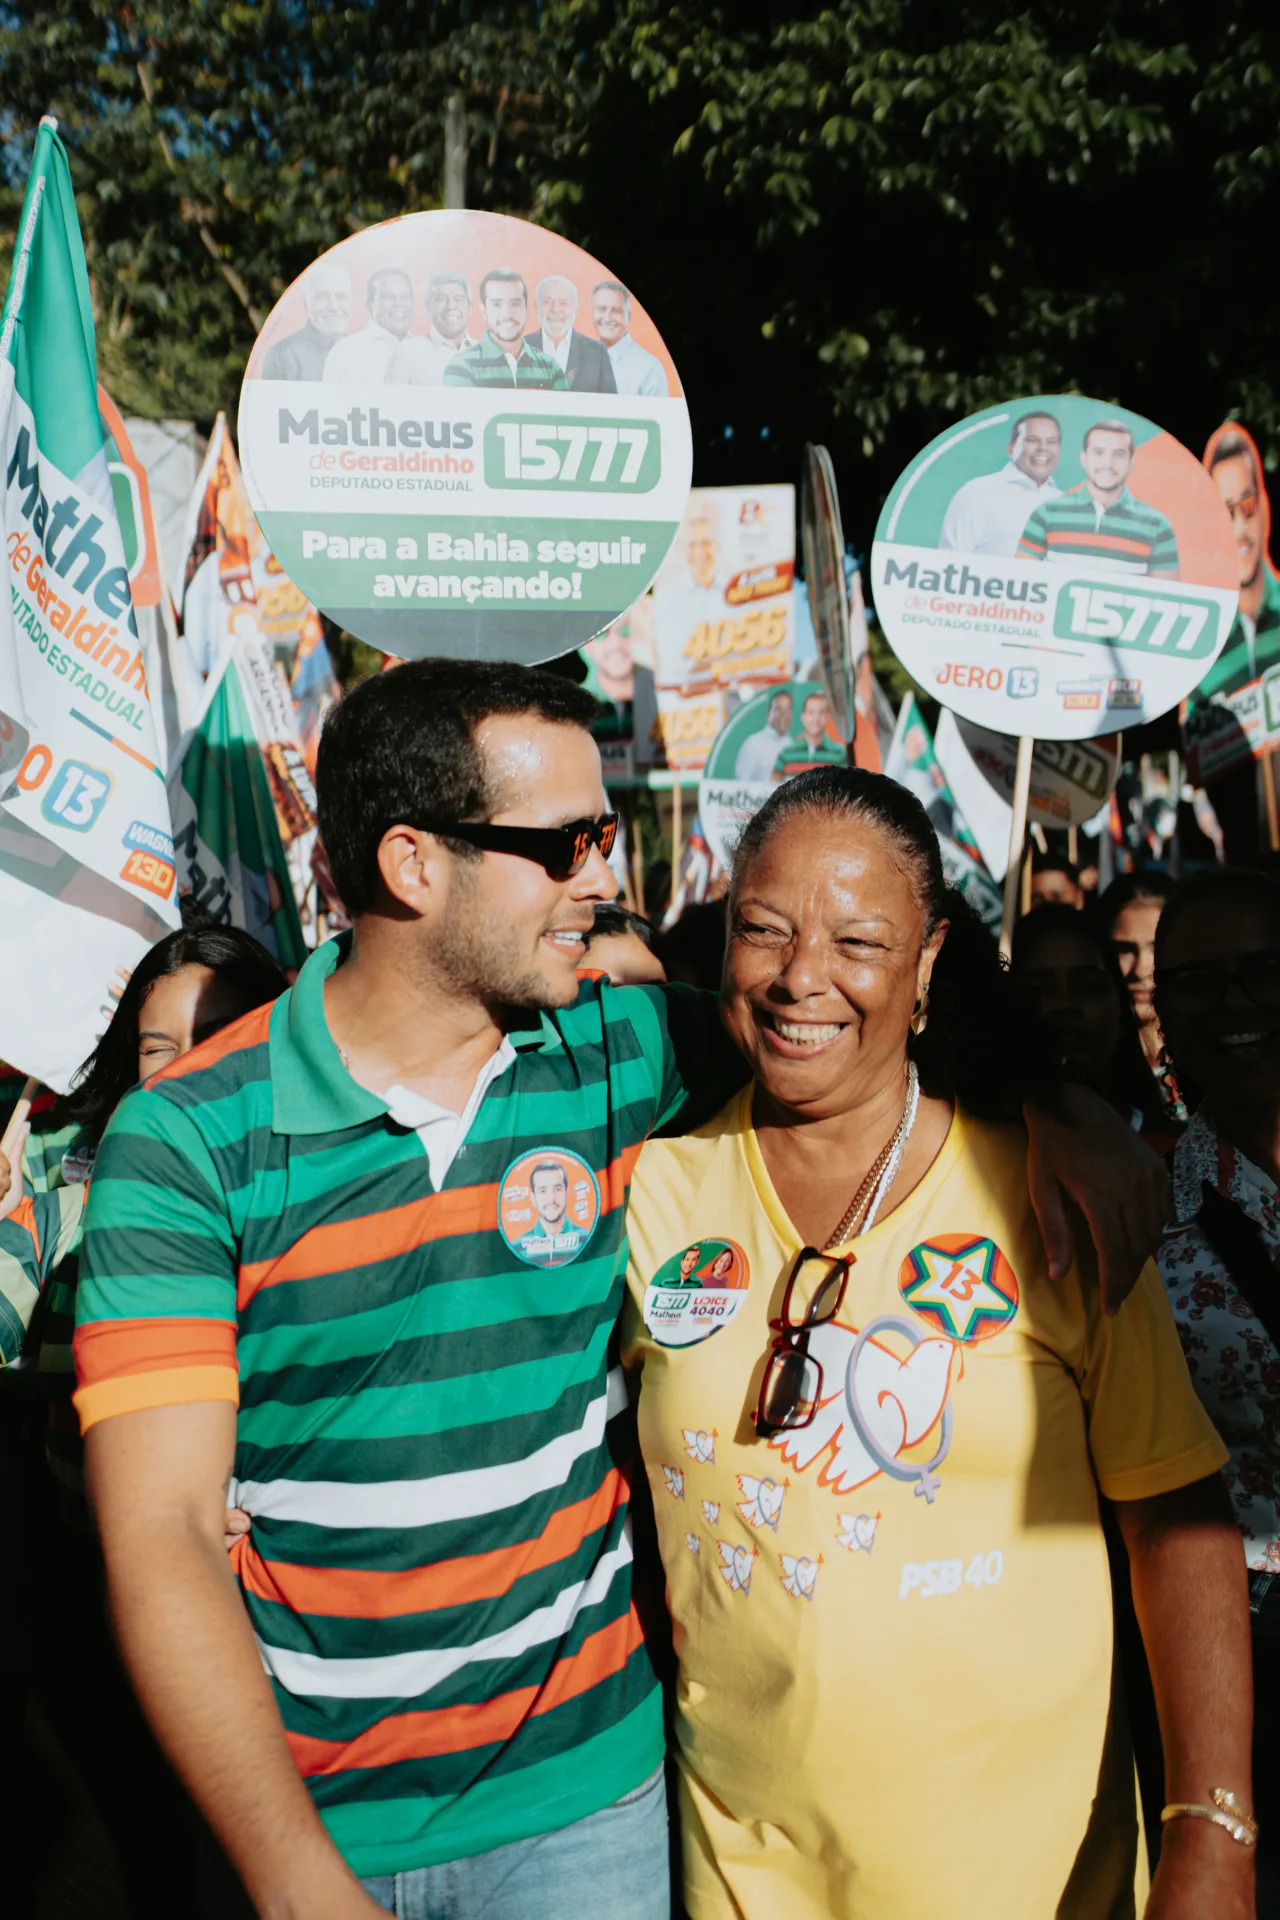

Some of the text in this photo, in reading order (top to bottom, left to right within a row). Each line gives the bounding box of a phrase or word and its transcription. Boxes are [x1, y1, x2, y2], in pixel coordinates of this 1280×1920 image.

[278, 407, 474, 450] Matheus
[309, 450, 475, 475] de Geraldinho
[496, 422, 649, 484] 15777
[310, 476, 474, 493] DEPUTADO ESTADUAL
[7, 424, 139, 640] Mathe
[302, 530, 646, 569] Para a Bahia seguir
[373, 570, 583, 604] avançando!
[883, 558, 1048, 604] Matheus
[25, 554, 150, 702] Geraldinh
[901, 612, 1041, 638] DEPUTADO ESTADUAL
[904, 594, 1045, 624] de Geraldinho
[1069, 585, 1210, 652] 15777
[46, 643, 145, 732] ESTADUAL
[936, 663, 1003, 690] JERO
[1011, 669, 1036, 696] 13
[52, 765, 107, 825] 13
[129, 852, 174, 891] 130
[939, 1263, 982, 1301] 13
[690, 1307, 725, 1316] 4040
[899, 1550, 1004, 1600] PSB 40
